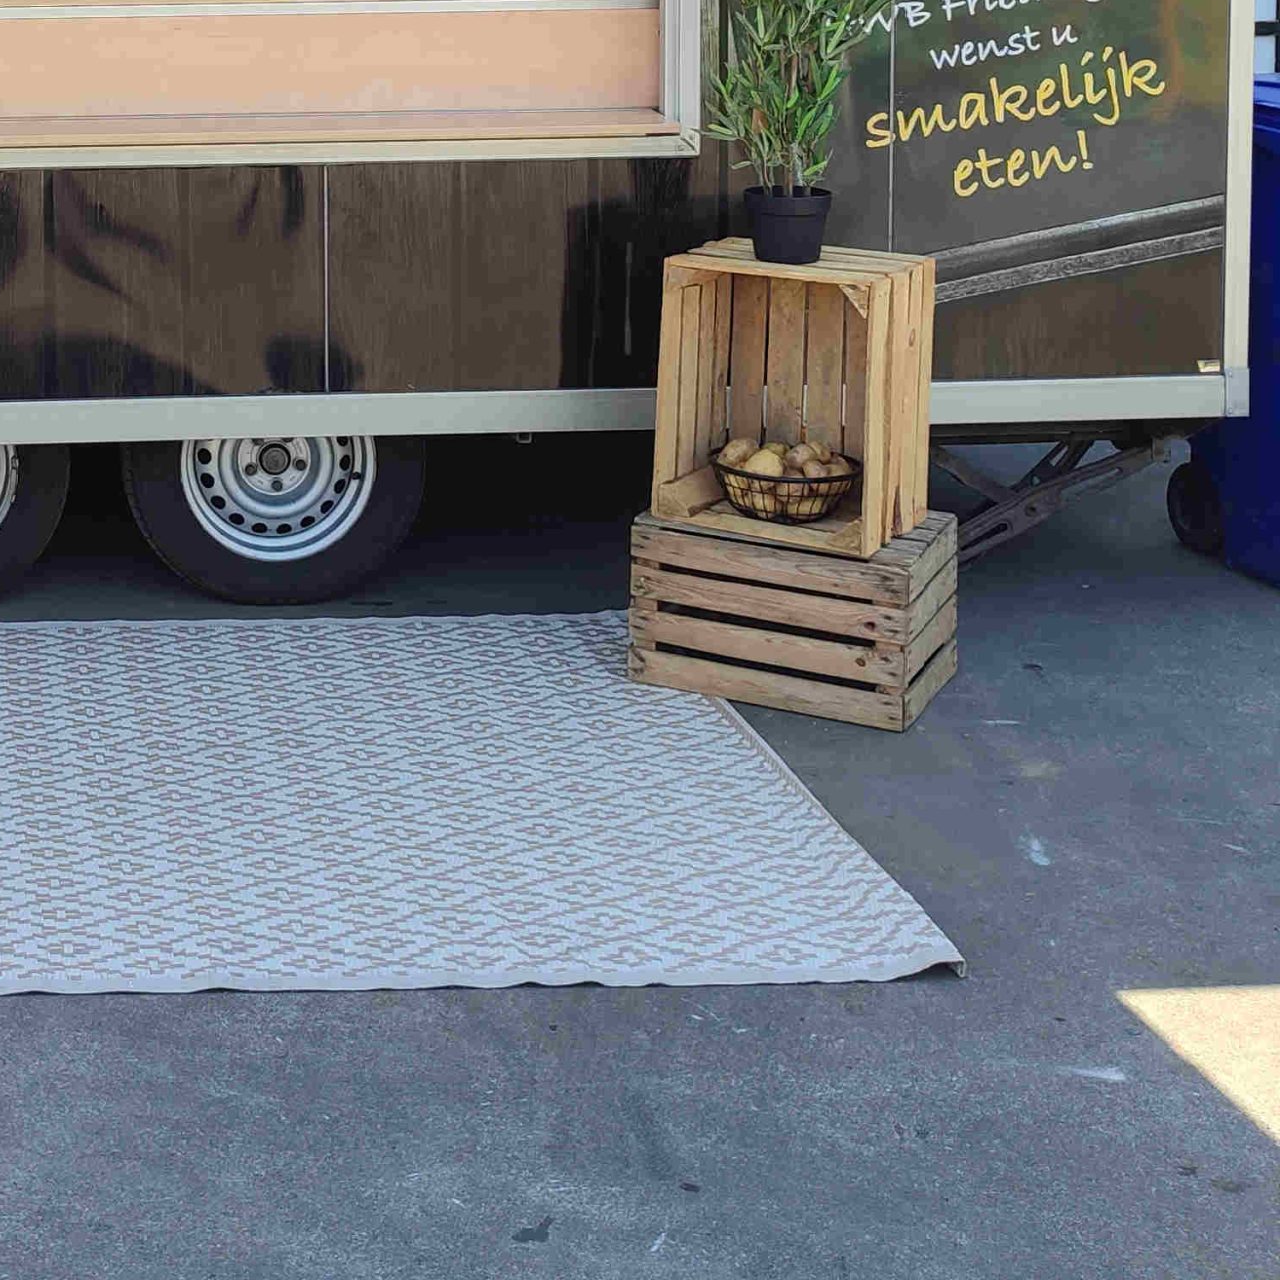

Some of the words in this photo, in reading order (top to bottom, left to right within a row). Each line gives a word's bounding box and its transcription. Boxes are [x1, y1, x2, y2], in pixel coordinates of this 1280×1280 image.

[827, 1, 932, 36] WB
[929, 32, 1041, 71] wenst
[1052, 23, 1078, 45] u
[865, 46, 1166, 150] smakelijk
[952, 130, 1093, 197] eten!
